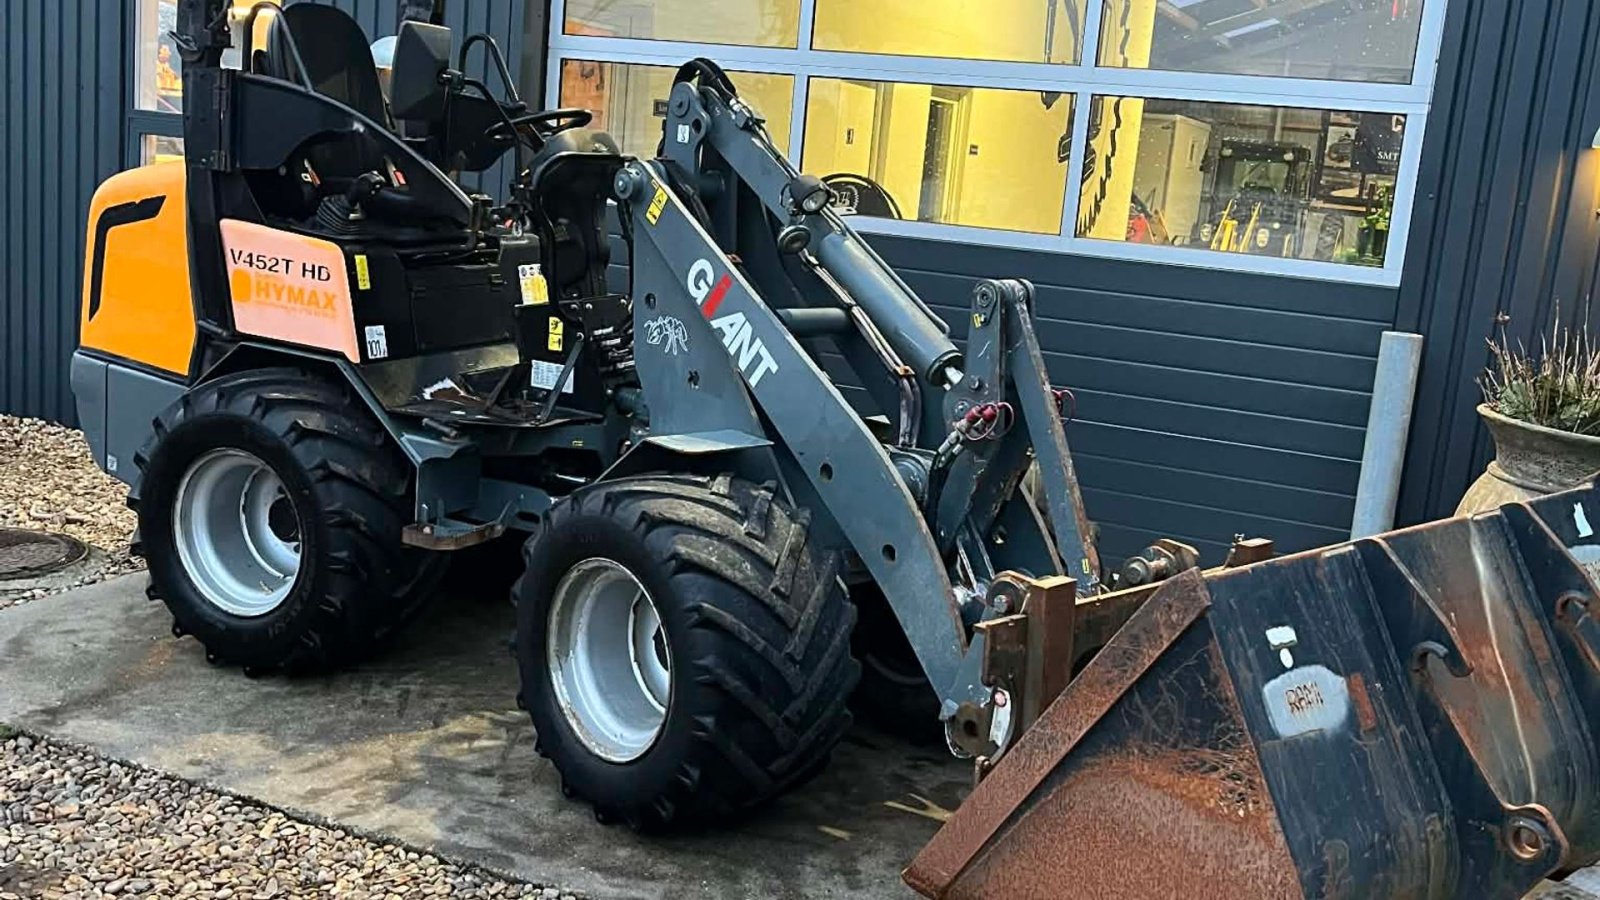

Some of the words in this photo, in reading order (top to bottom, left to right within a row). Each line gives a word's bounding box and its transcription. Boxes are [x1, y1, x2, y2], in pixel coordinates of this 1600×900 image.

[230, 248, 294, 275] V452T
[302, 262, 331, 282] HD
[256, 281, 336, 309] HYMAX
[687, 258, 779, 388] GIANT
